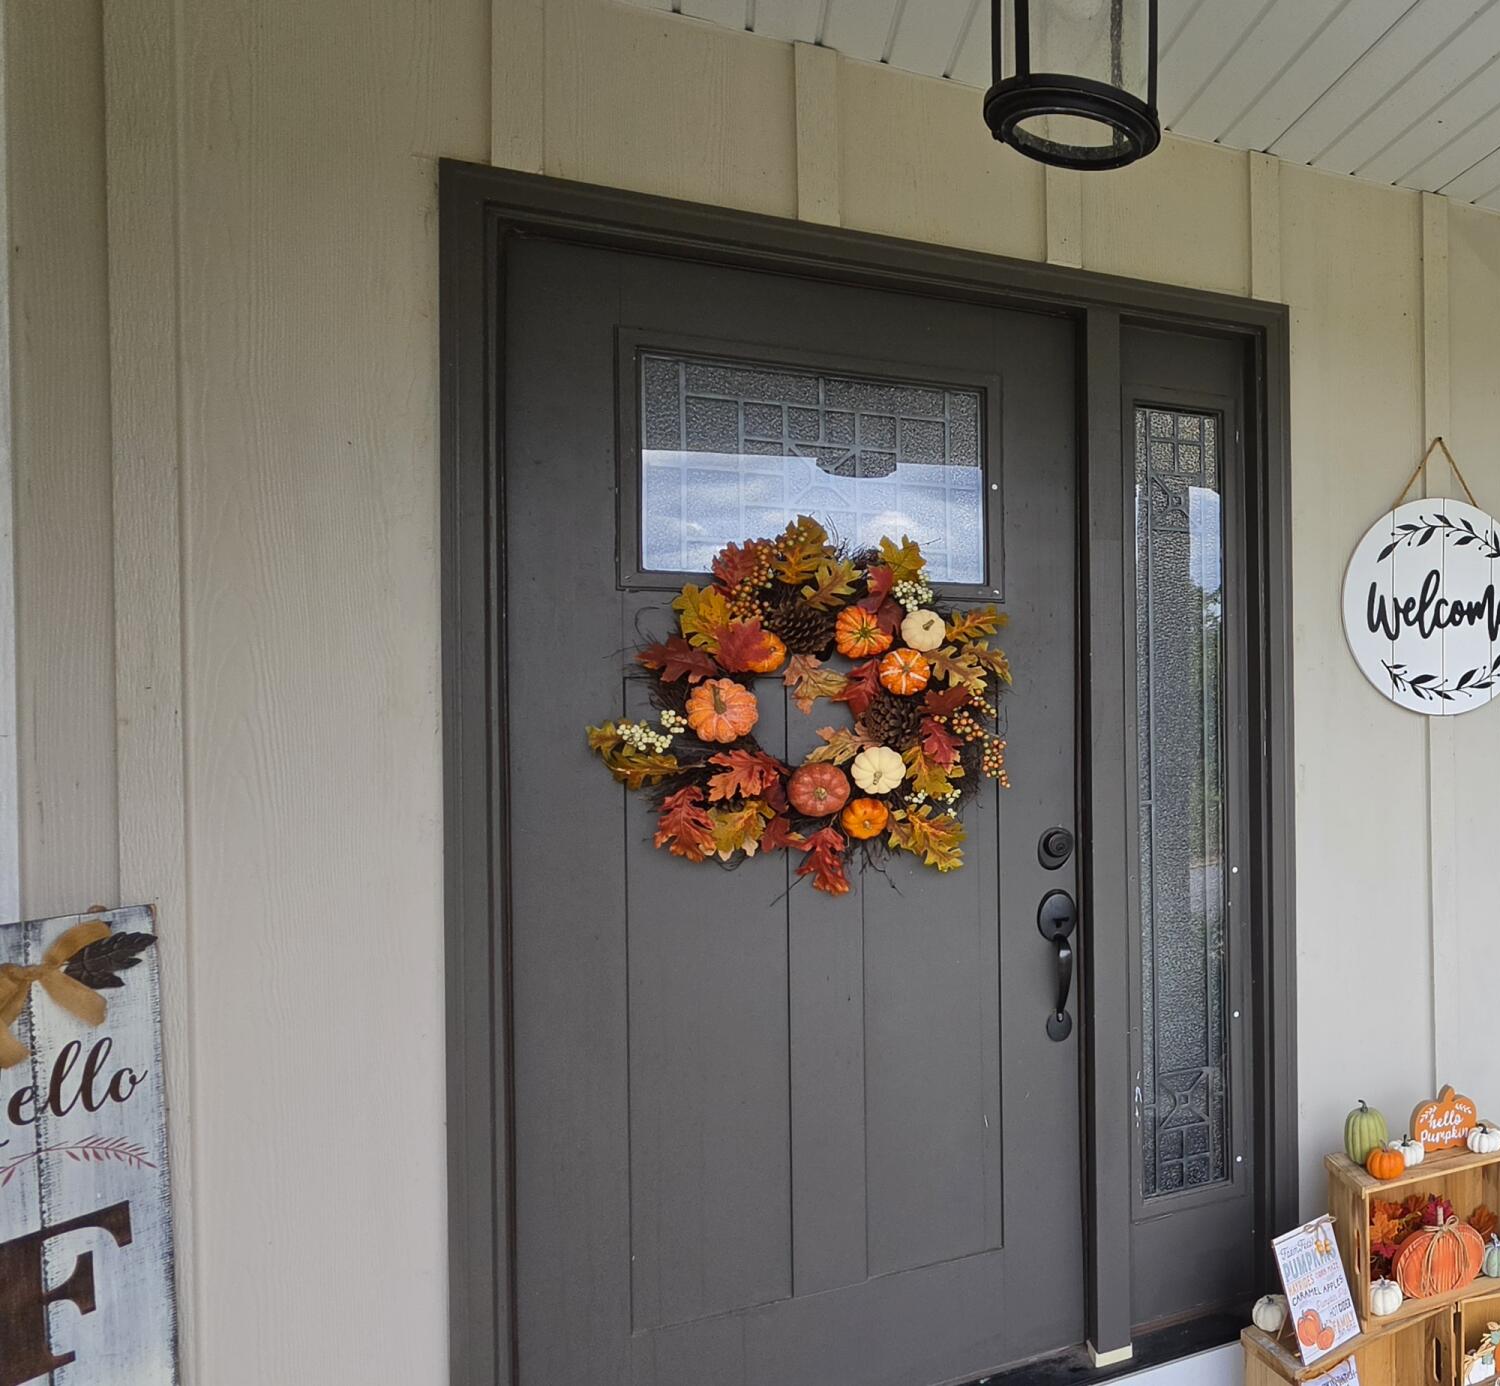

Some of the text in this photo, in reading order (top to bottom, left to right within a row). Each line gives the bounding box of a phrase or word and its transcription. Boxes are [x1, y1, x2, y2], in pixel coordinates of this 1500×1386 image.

[0, 1036, 149, 1147] ello
[1427, 1109, 1464, 1129] hello
[1292, 1286, 1323, 1307] CARAMEL
[1322, 1275, 1344, 1294] APPLES
